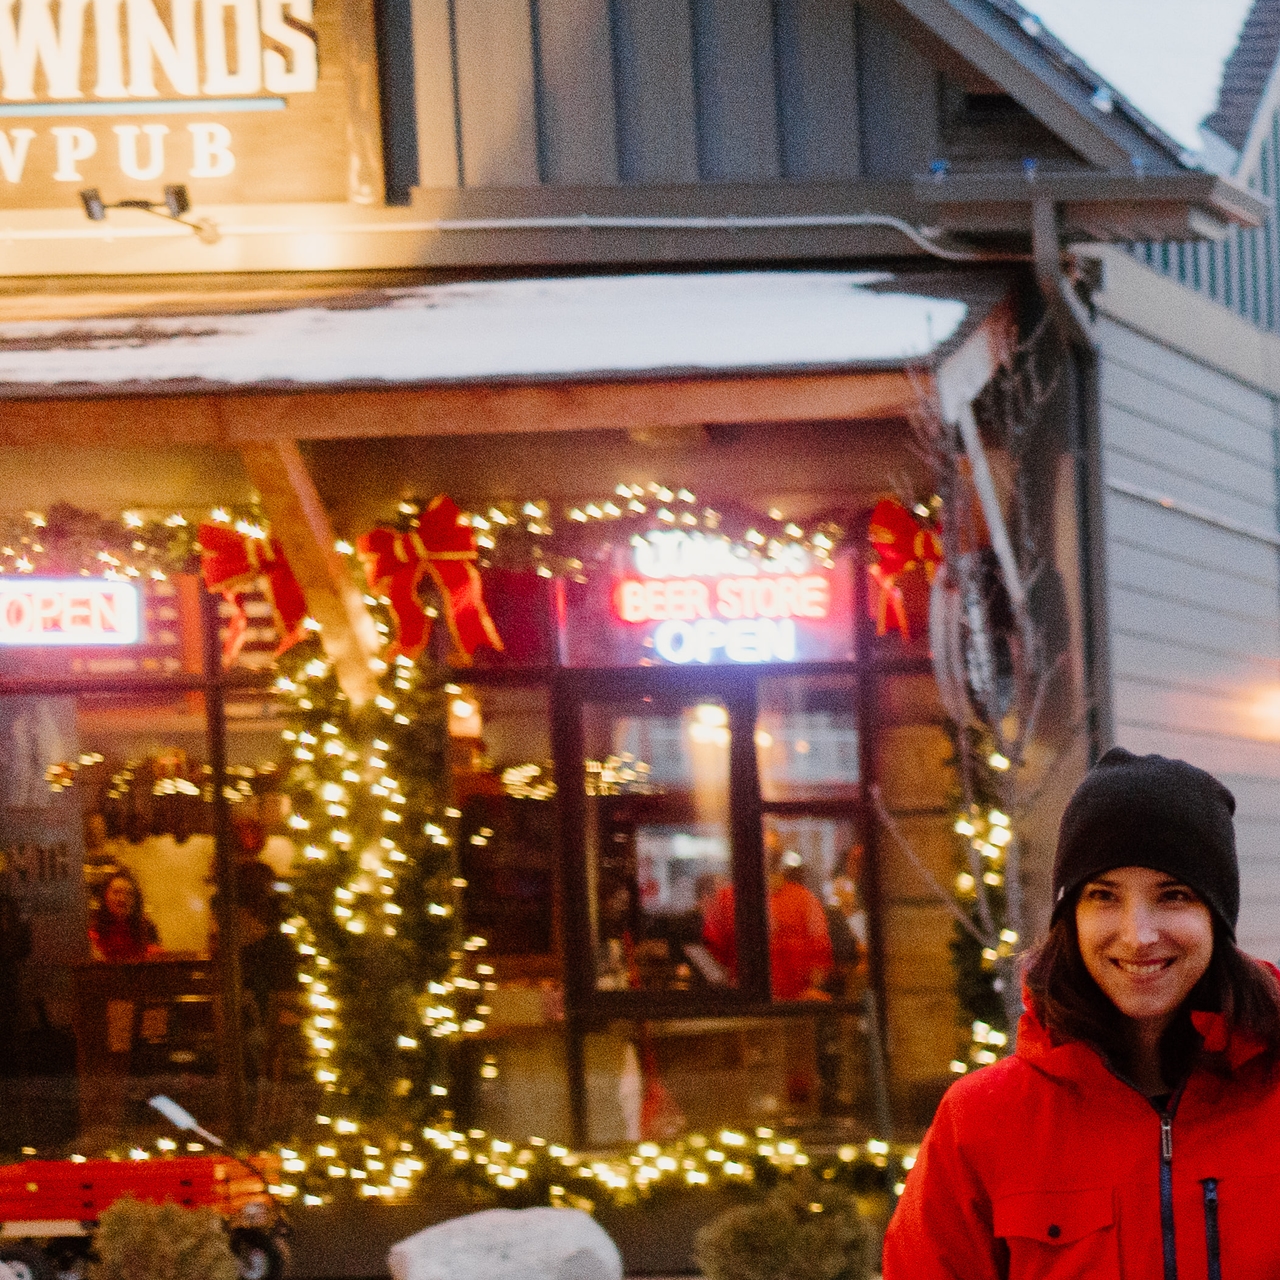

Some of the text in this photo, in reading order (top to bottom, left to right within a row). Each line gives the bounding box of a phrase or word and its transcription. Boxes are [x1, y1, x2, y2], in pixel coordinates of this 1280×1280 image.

[0, 0, 318, 98] WINDS
[0, 590, 122, 634] OPEN
[621, 576, 828, 622] BEER STORE
[655, 618, 796, 663] OPEN
